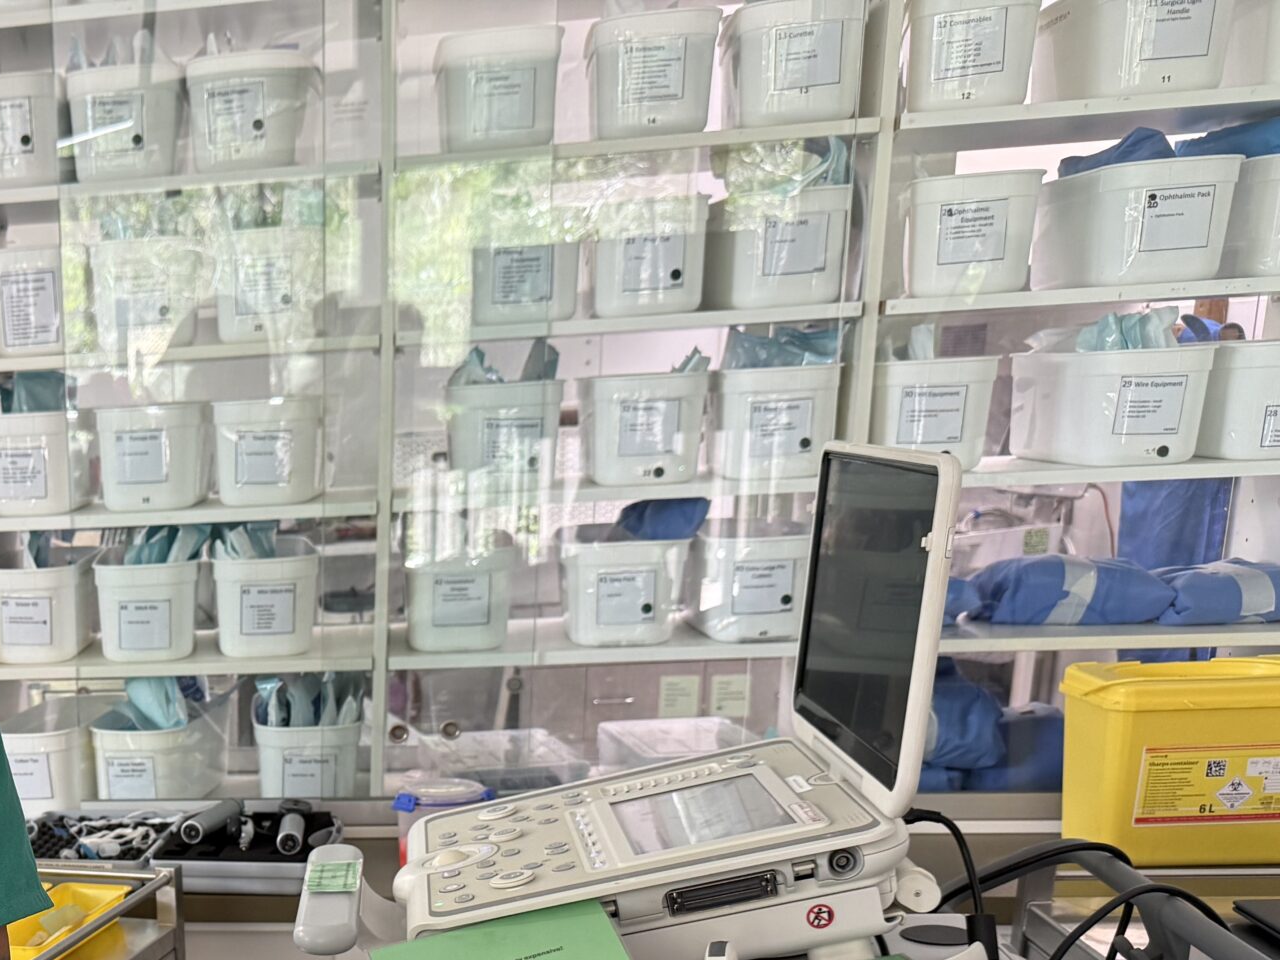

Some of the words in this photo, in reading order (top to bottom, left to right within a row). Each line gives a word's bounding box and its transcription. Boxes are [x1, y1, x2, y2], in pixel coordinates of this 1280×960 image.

[1166, 7, 1190, 15] Handle
[1160, 75, 1172, 84] 11
[1159, 192, 1197, 202] Ophthalmic
[1197, 191, 1211, 200] Pack
[1147, 201, 1158, 209] 20
[1122, 380, 1133, 388] 29
[1150, 380, 1183, 388] Equipment
[1199, 803, 1207, 814] 6
[1208, 803, 1216, 814] L
